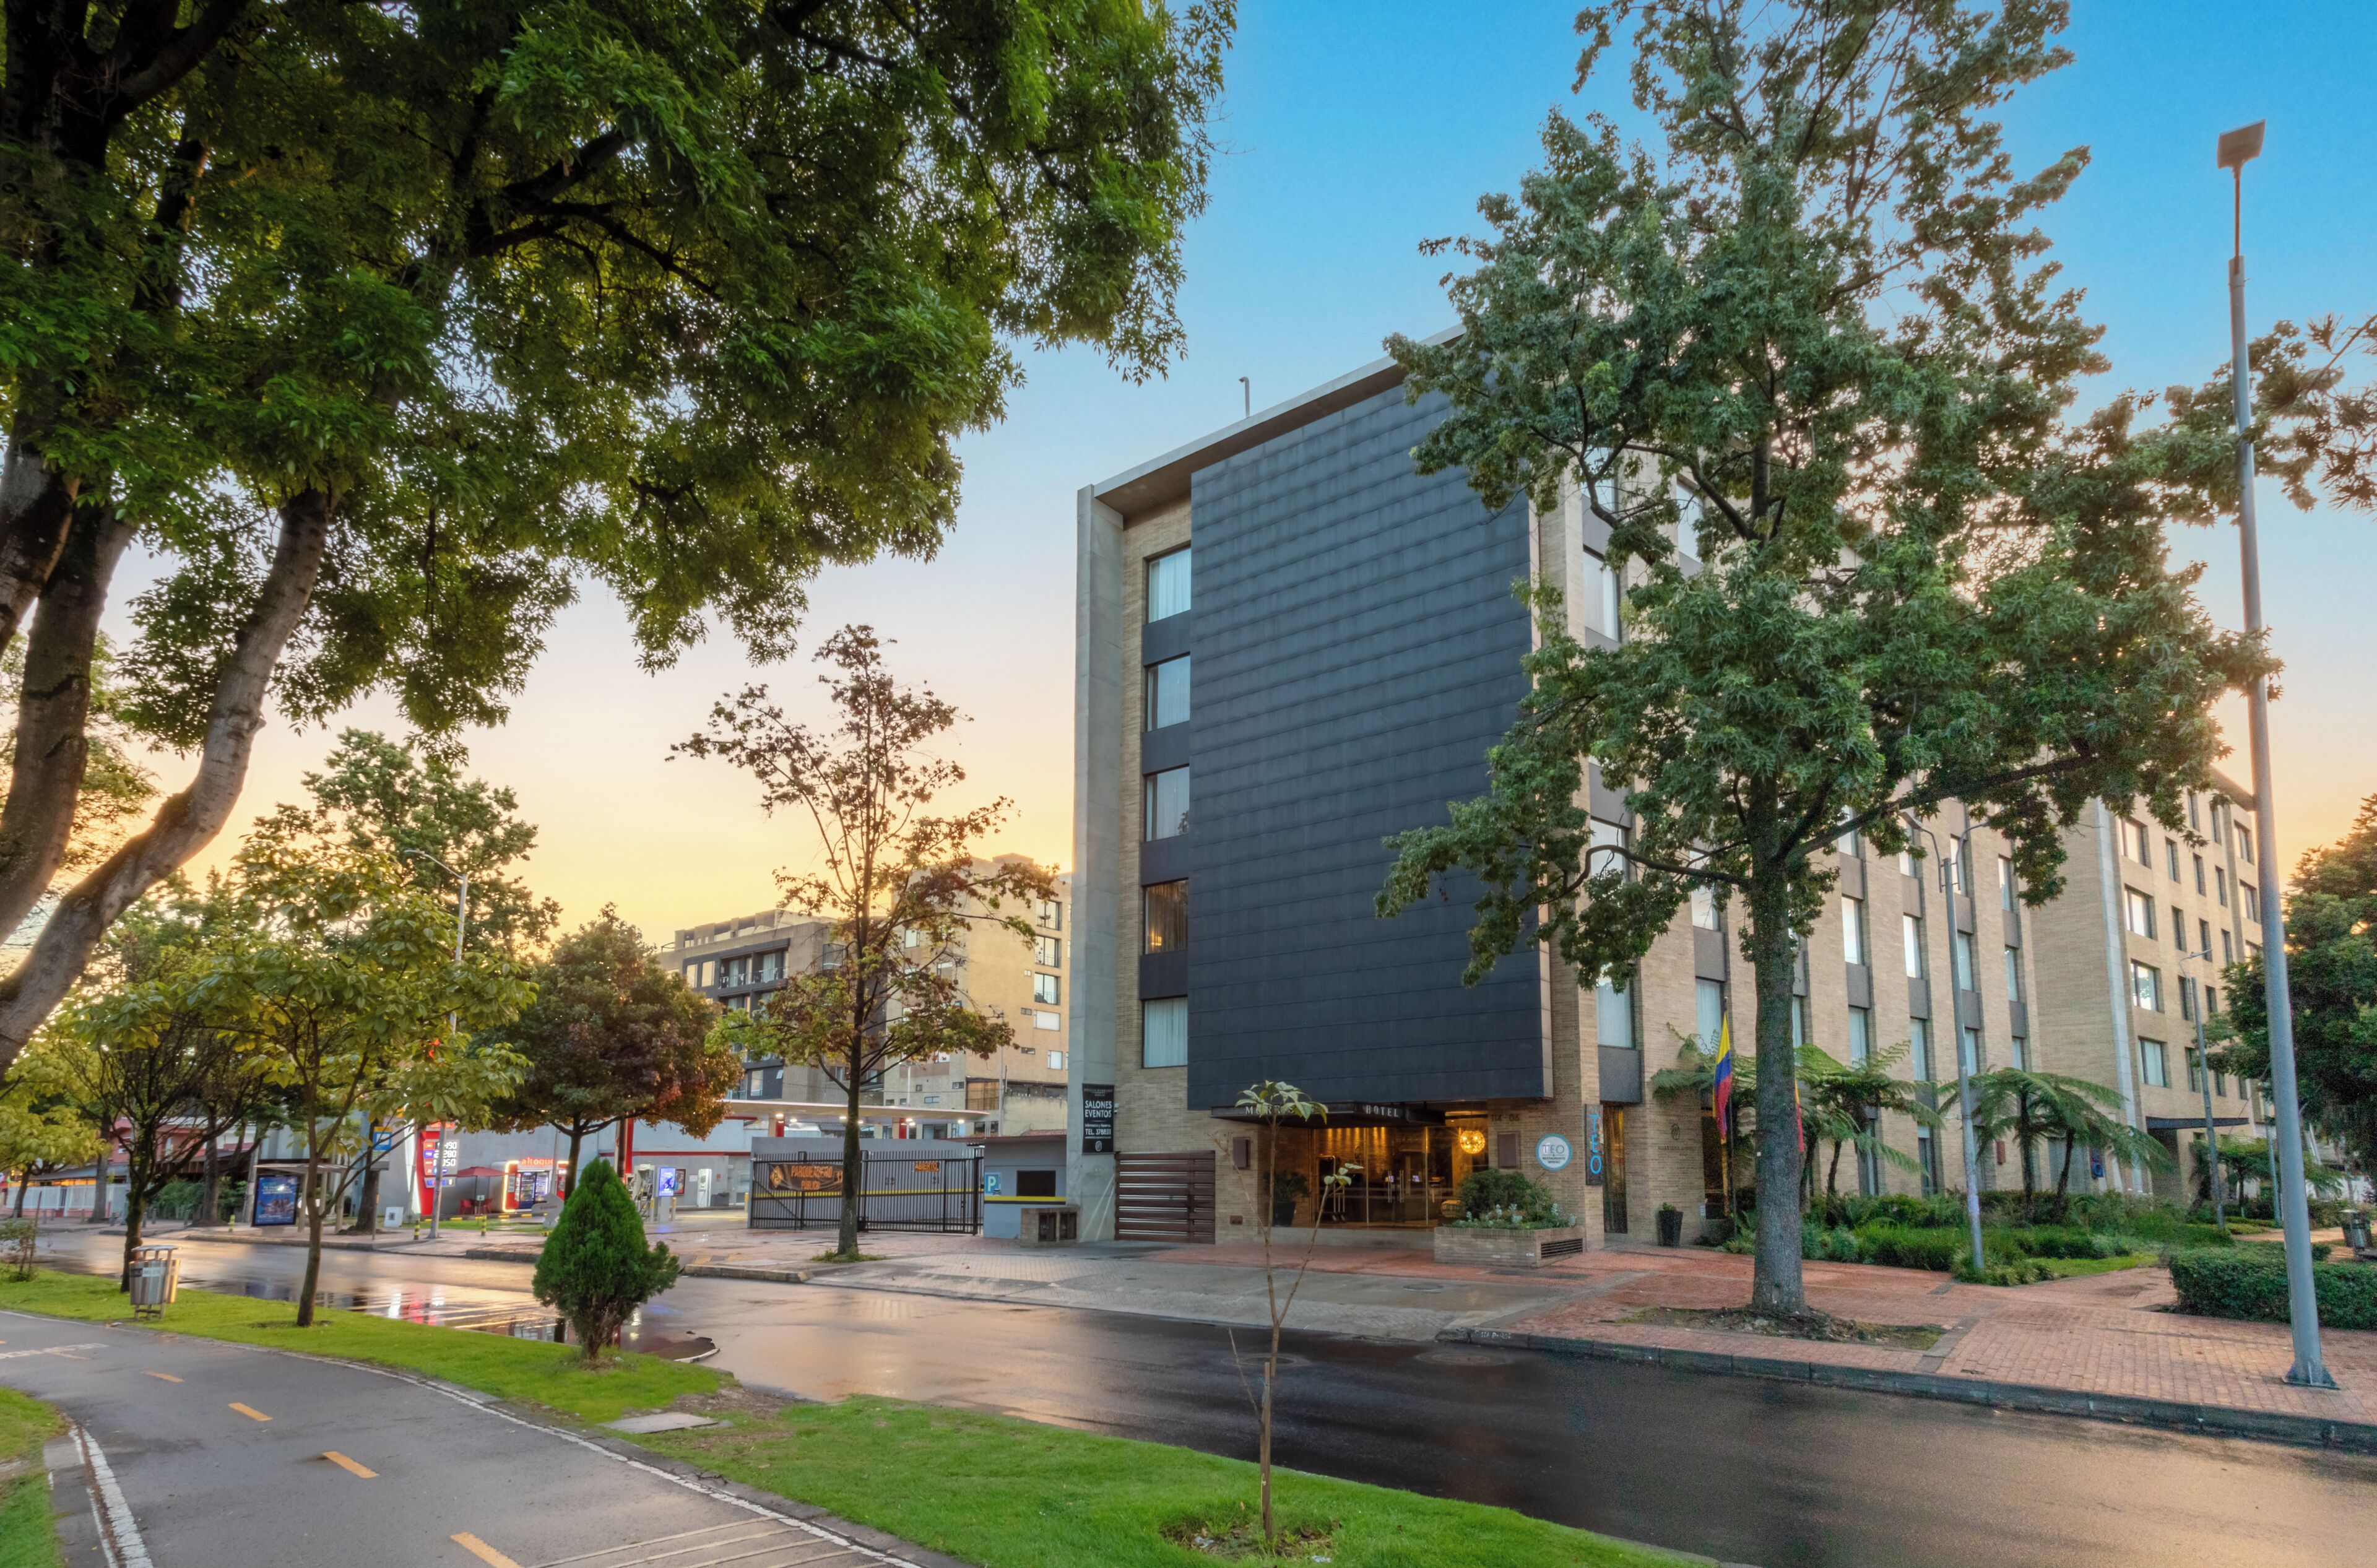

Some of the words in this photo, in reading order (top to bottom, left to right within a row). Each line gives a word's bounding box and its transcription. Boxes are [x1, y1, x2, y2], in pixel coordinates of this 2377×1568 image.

[1085, 1101, 1112, 1109] SALONES
[1085, 1109, 1112, 1118] EVENTOS
[1366, 1105, 1398, 1117] HOTEL
[1589, 1113, 1602, 1175] TEO
[1542, 1145, 1565, 1154] TEO
[914, 1161, 938, 1171] ABIERTO
[987, 1176, 996, 1192] P
